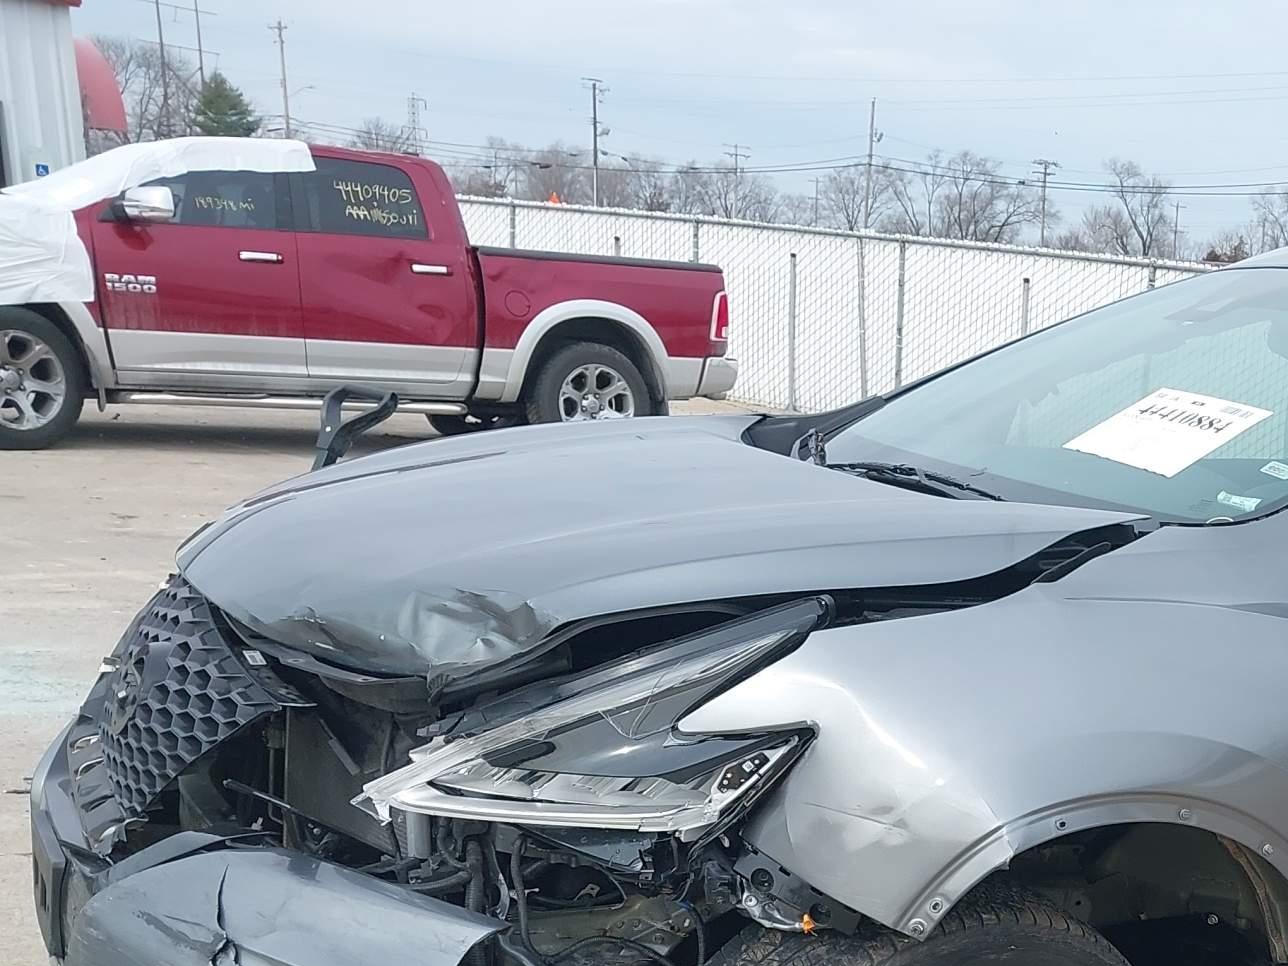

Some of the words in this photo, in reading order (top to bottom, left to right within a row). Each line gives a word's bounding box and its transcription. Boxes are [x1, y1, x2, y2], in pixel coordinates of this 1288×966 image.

[333, 180, 412, 204] 44409405
[104, 273, 156, 284] RAM
[105, 282, 157, 293] 1500
[1138, 404, 1233, 434] 44410884
